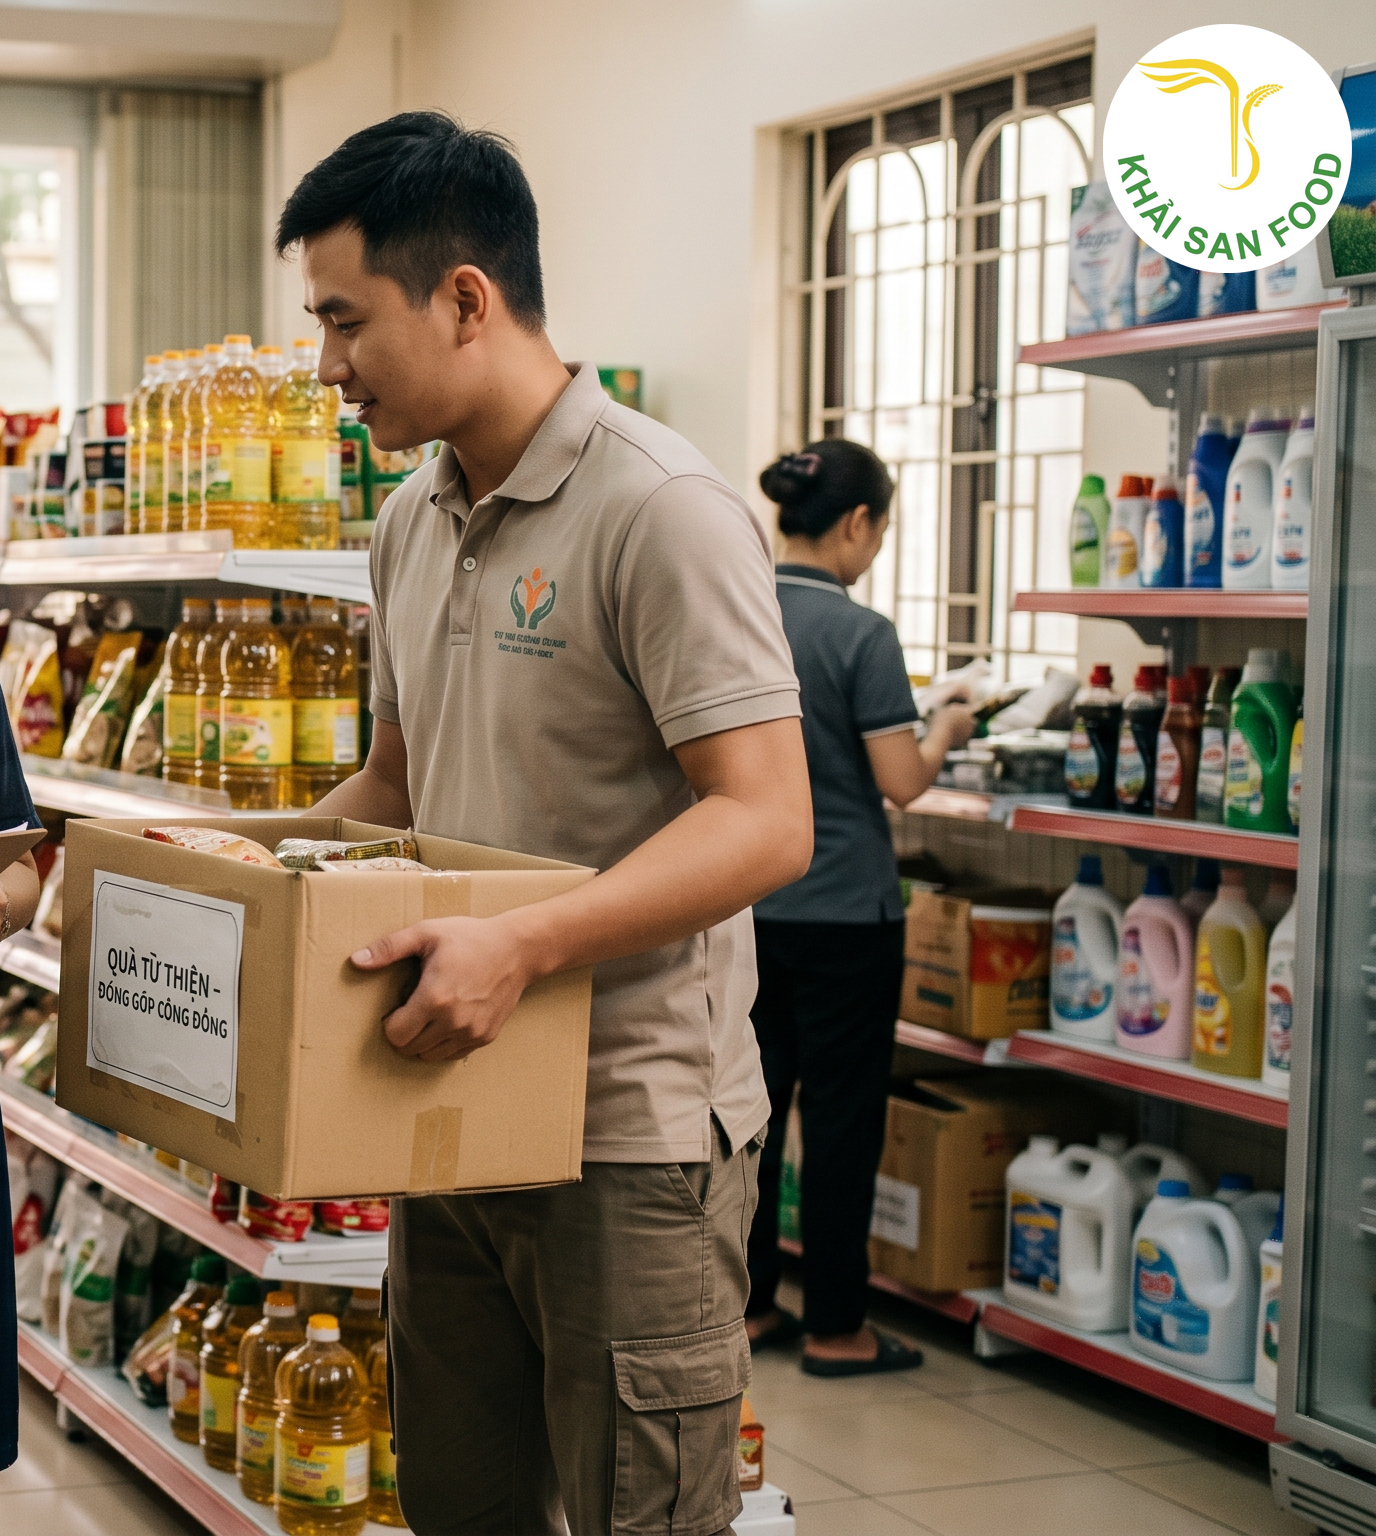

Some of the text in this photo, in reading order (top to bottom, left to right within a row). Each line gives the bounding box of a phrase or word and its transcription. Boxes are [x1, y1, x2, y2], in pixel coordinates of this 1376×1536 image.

[108, 946, 138, 977] QUÀ
[141, 951, 162, 983] TỪ
[164, 963, 209, 1003] THIỆN
[98, 980, 130, 1007] ĐÓNG
[157, 997, 189, 1026] CÔNG
